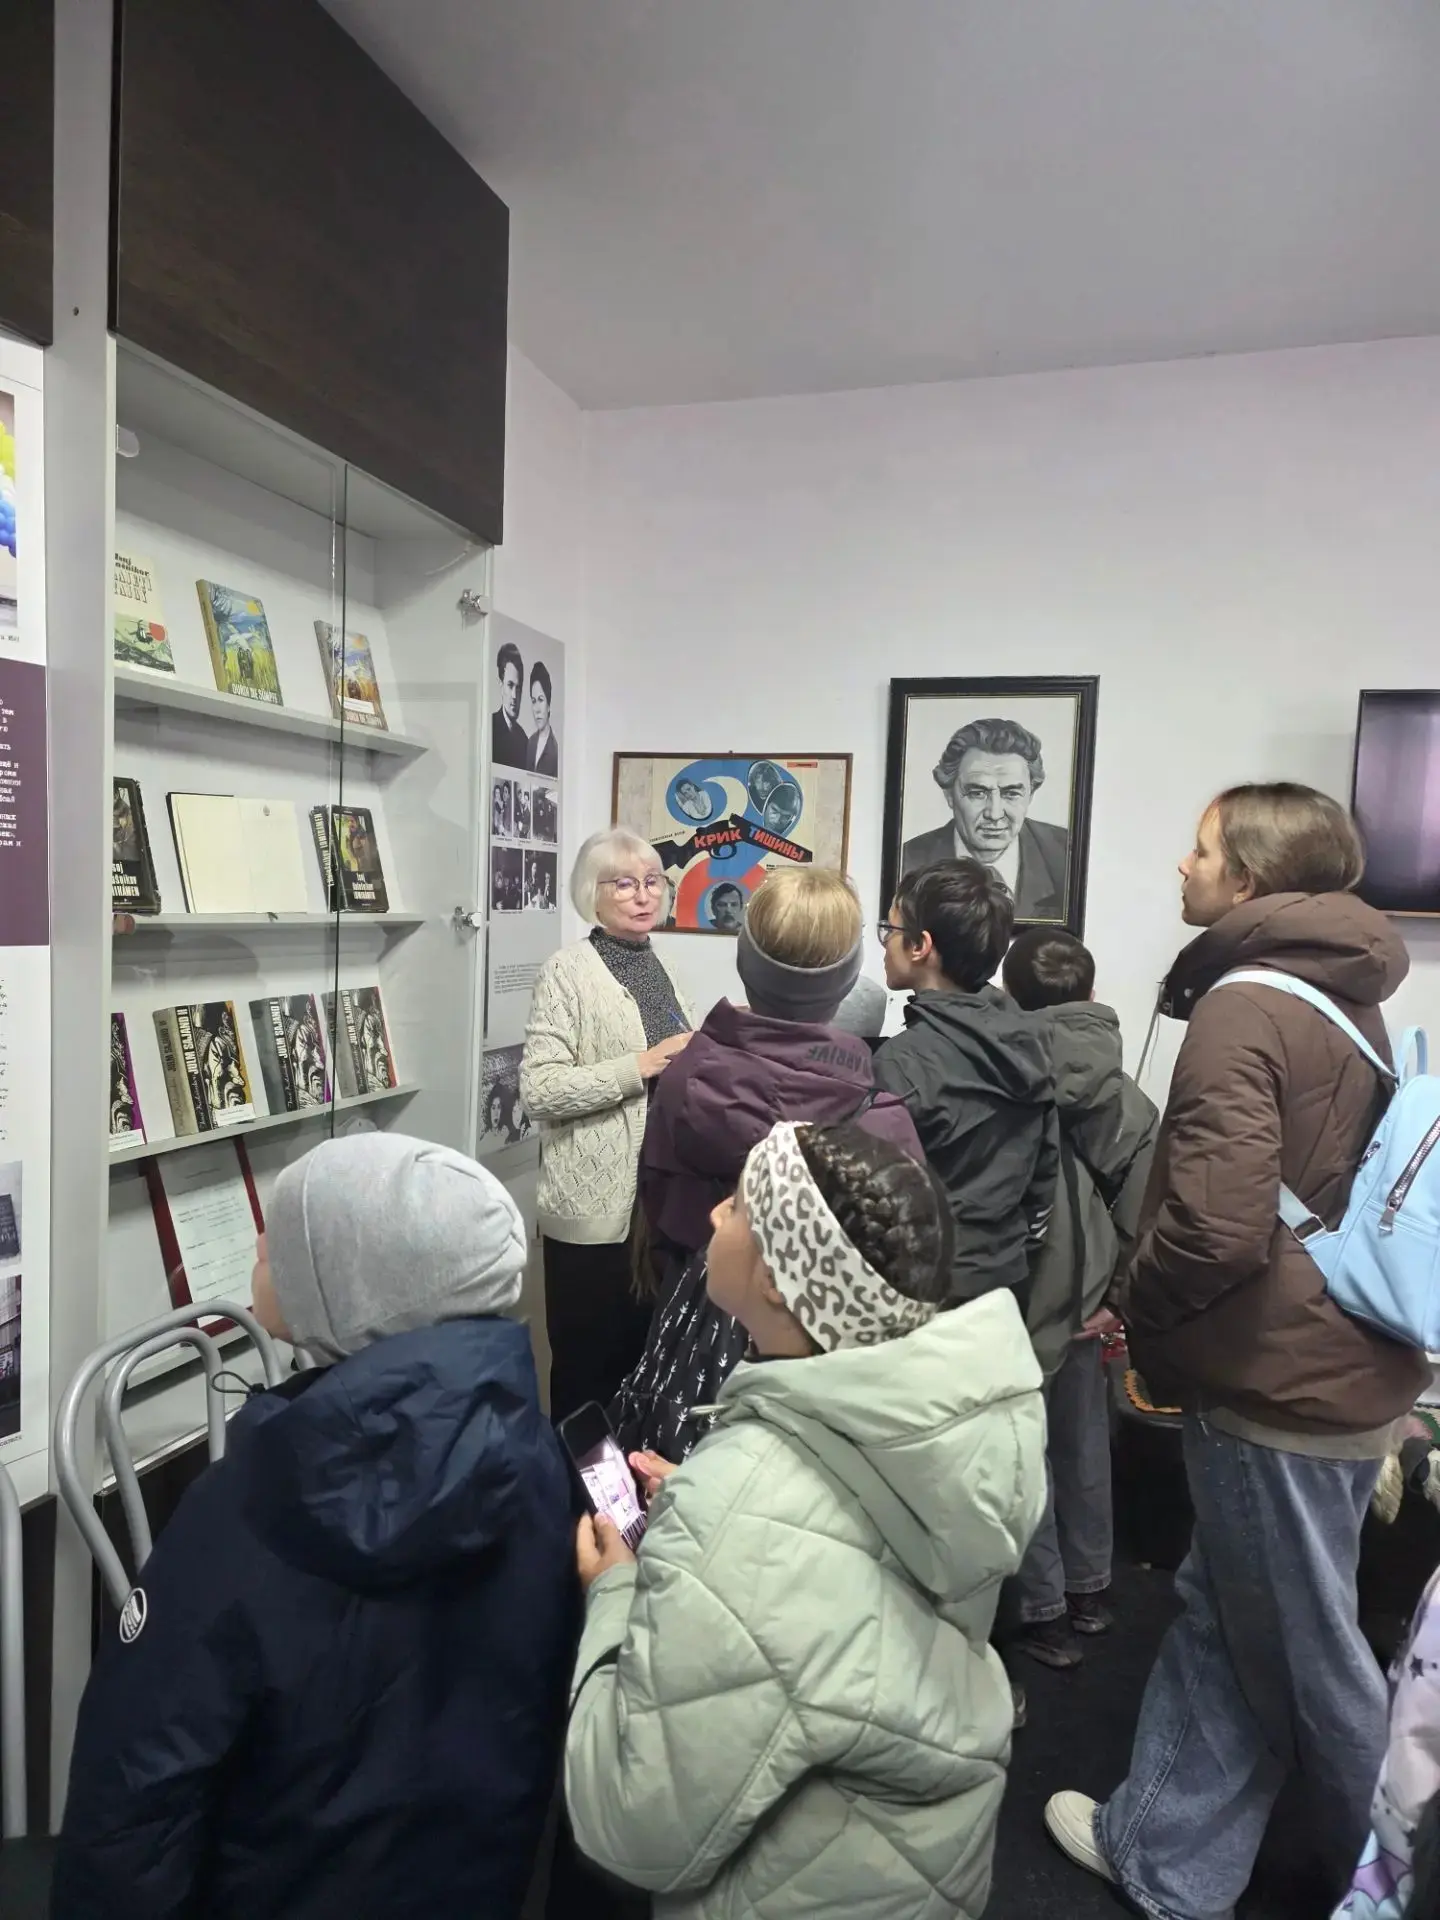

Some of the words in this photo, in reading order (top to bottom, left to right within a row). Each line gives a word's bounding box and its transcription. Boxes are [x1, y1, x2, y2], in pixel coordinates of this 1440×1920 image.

[693, 828, 743, 850] КРИК
[749, 825, 806, 862] ТИШИНЫ
[177, 1016, 194, 1050] SAJAND
[270, 1005, 284, 1036] SAJAND
[275, 1037, 289, 1059] JULM
[347, 1025, 358, 1046] JULM
[184, 1050, 199, 1075] JULM
